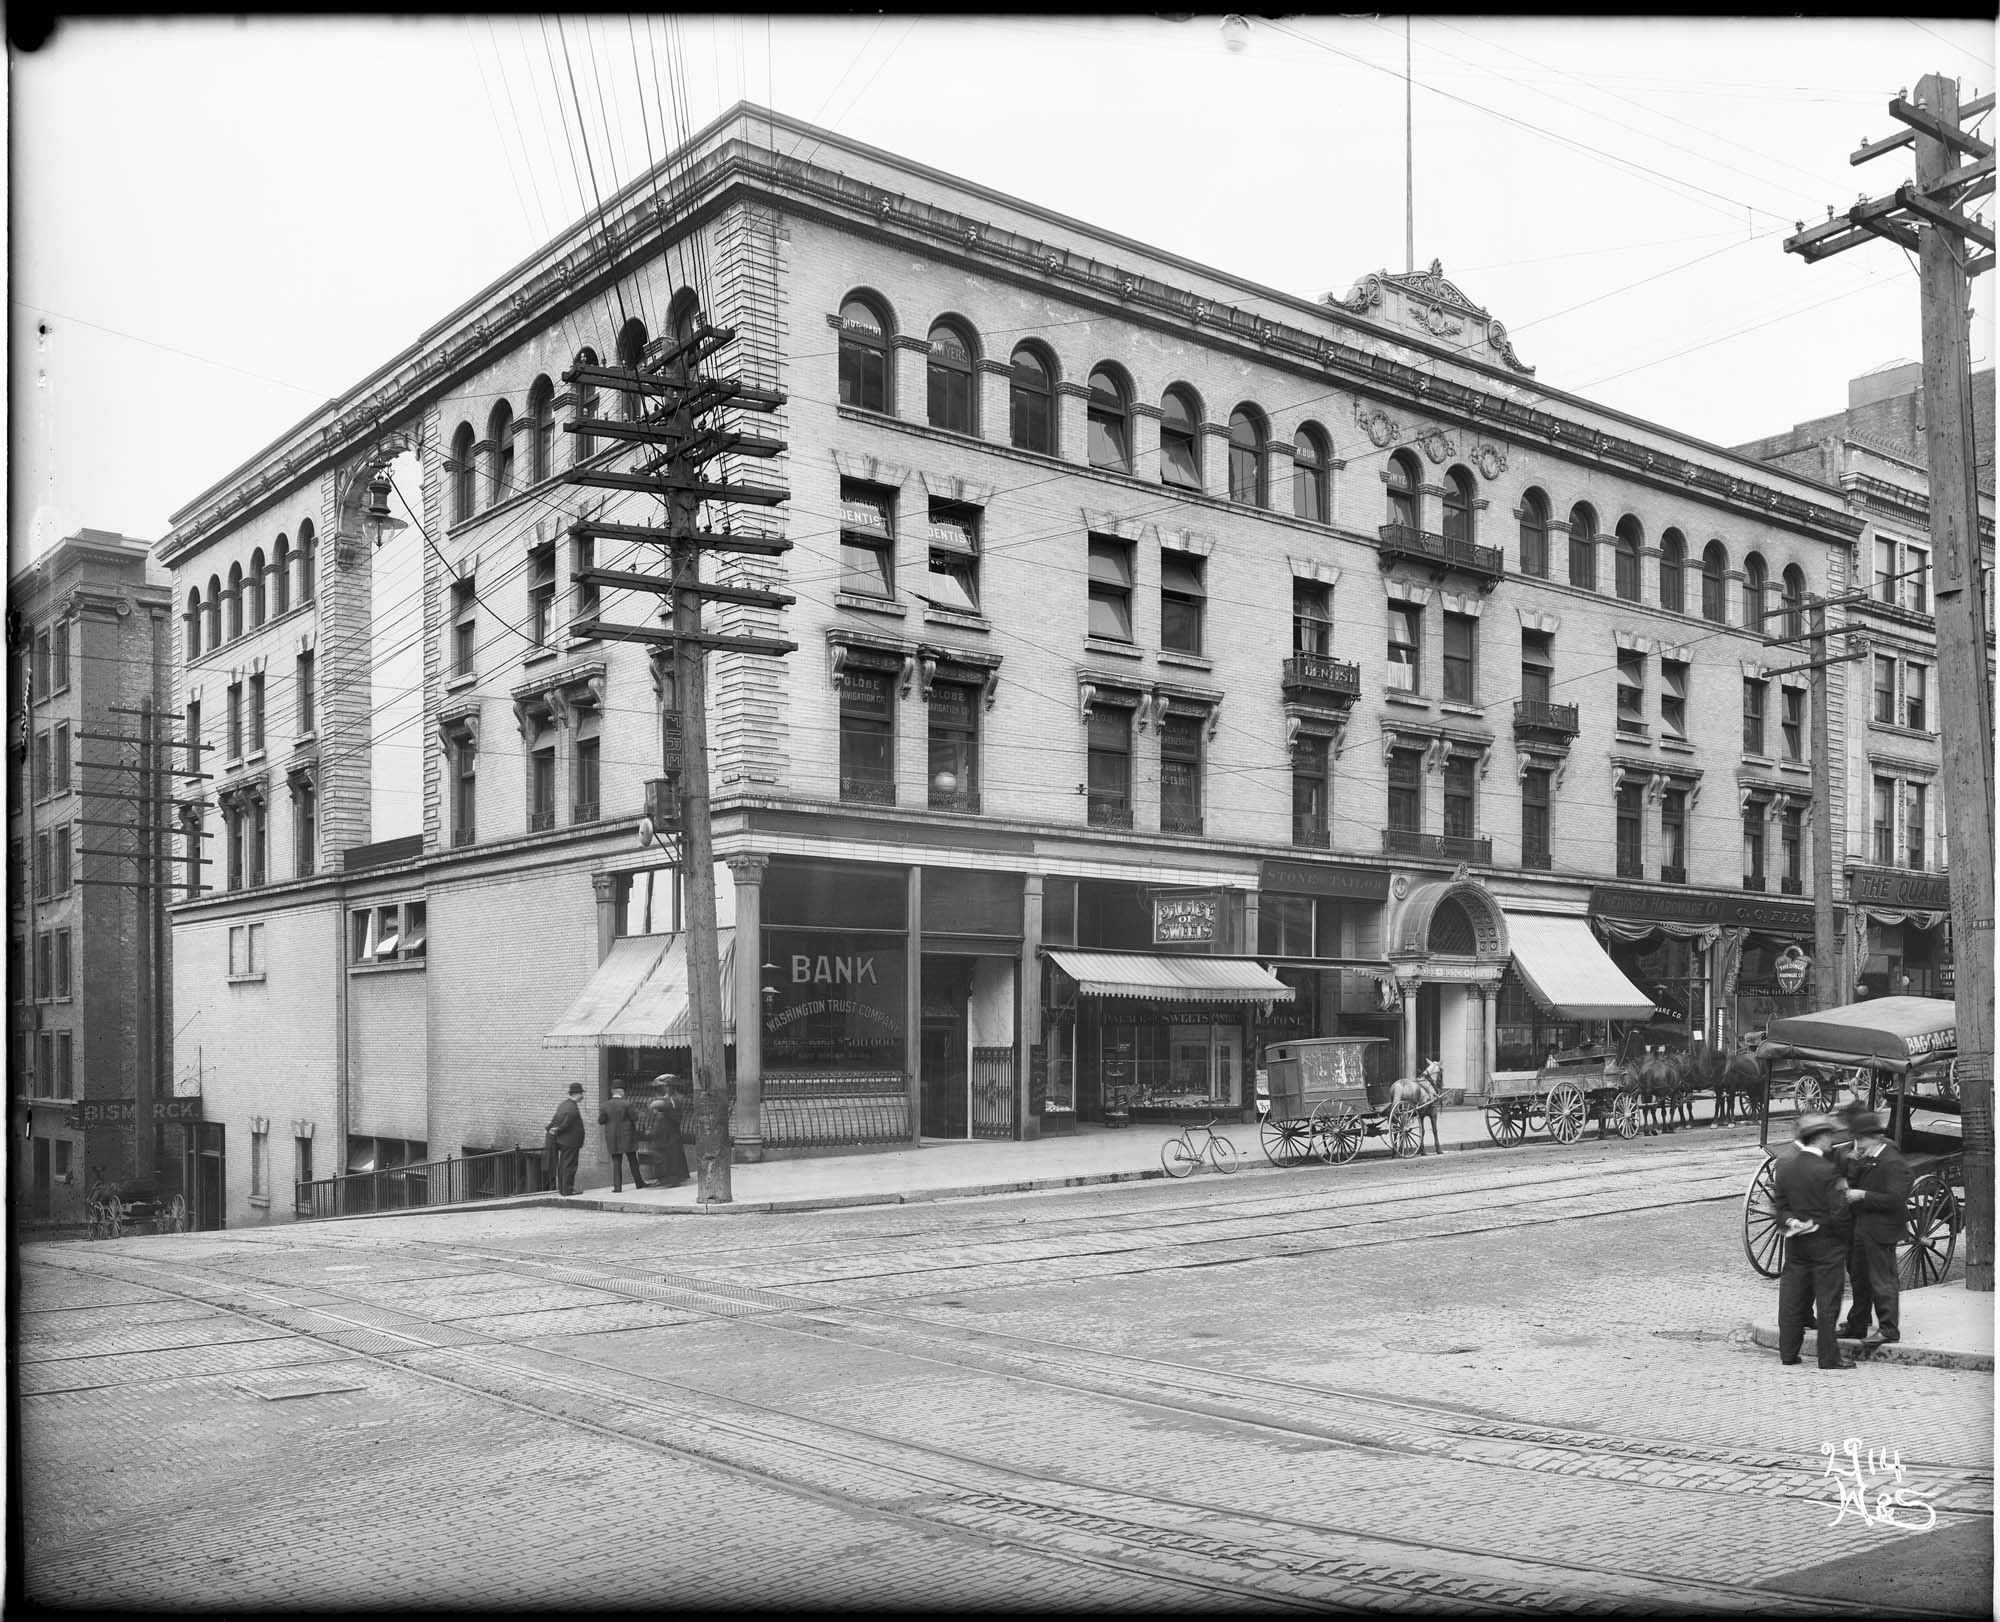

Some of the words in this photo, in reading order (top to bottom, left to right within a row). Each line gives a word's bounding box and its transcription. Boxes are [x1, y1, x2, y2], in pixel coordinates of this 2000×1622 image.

[840, 508, 887, 529] DENTIST
[844, 677, 880, 690] GLOBE
[666, 712, 681, 768] FIRE
[1267, 871, 1319, 888] STONE
[1861, 874, 1891, 899] THE
[1158, 901, 1216, 925] PALACE
[1179, 915, 1195, 923] OF
[1770, 911, 1816, 924] FILS
[1160, 923, 1215, 940] SWEETS
[792, 955, 877, 984] BANK
[766, 1000, 826, 1033] WASHINGTON
[827, 1000, 857, 1013] TRUST
[858, 1004, 900, 1033] COMPANY
[1160, 1014, 1208, 1025] SWEETS
[1905, 1029, 1955, 1054] BAGGAGE
[84, 1102, 200, 1121] BISMRCK.
